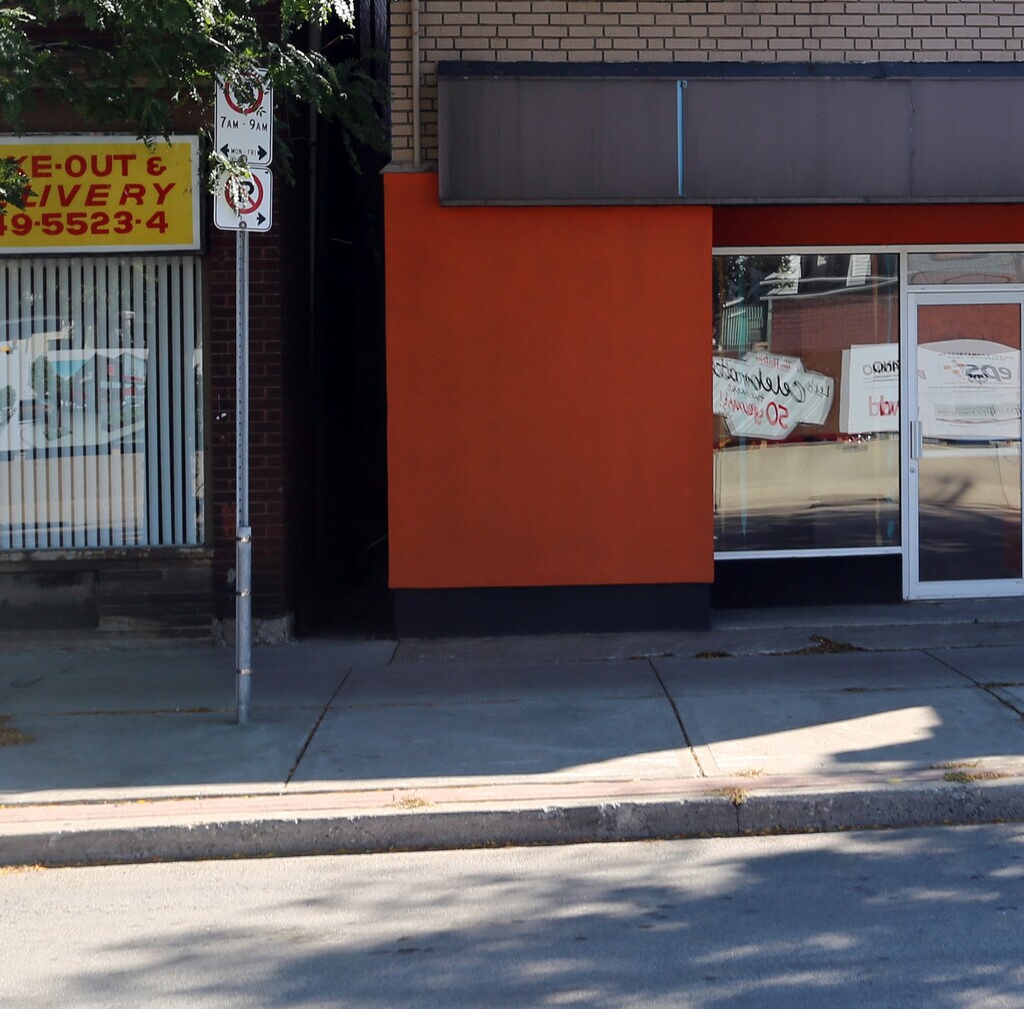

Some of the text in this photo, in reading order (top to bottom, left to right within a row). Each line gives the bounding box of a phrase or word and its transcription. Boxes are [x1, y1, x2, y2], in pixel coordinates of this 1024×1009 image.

[220, 116, 239, 129] 7AM
[249, 118, 268, 132] 9AM
[147, 156, 167, 176] &
[0, 182, 176, 208] LIVERY
